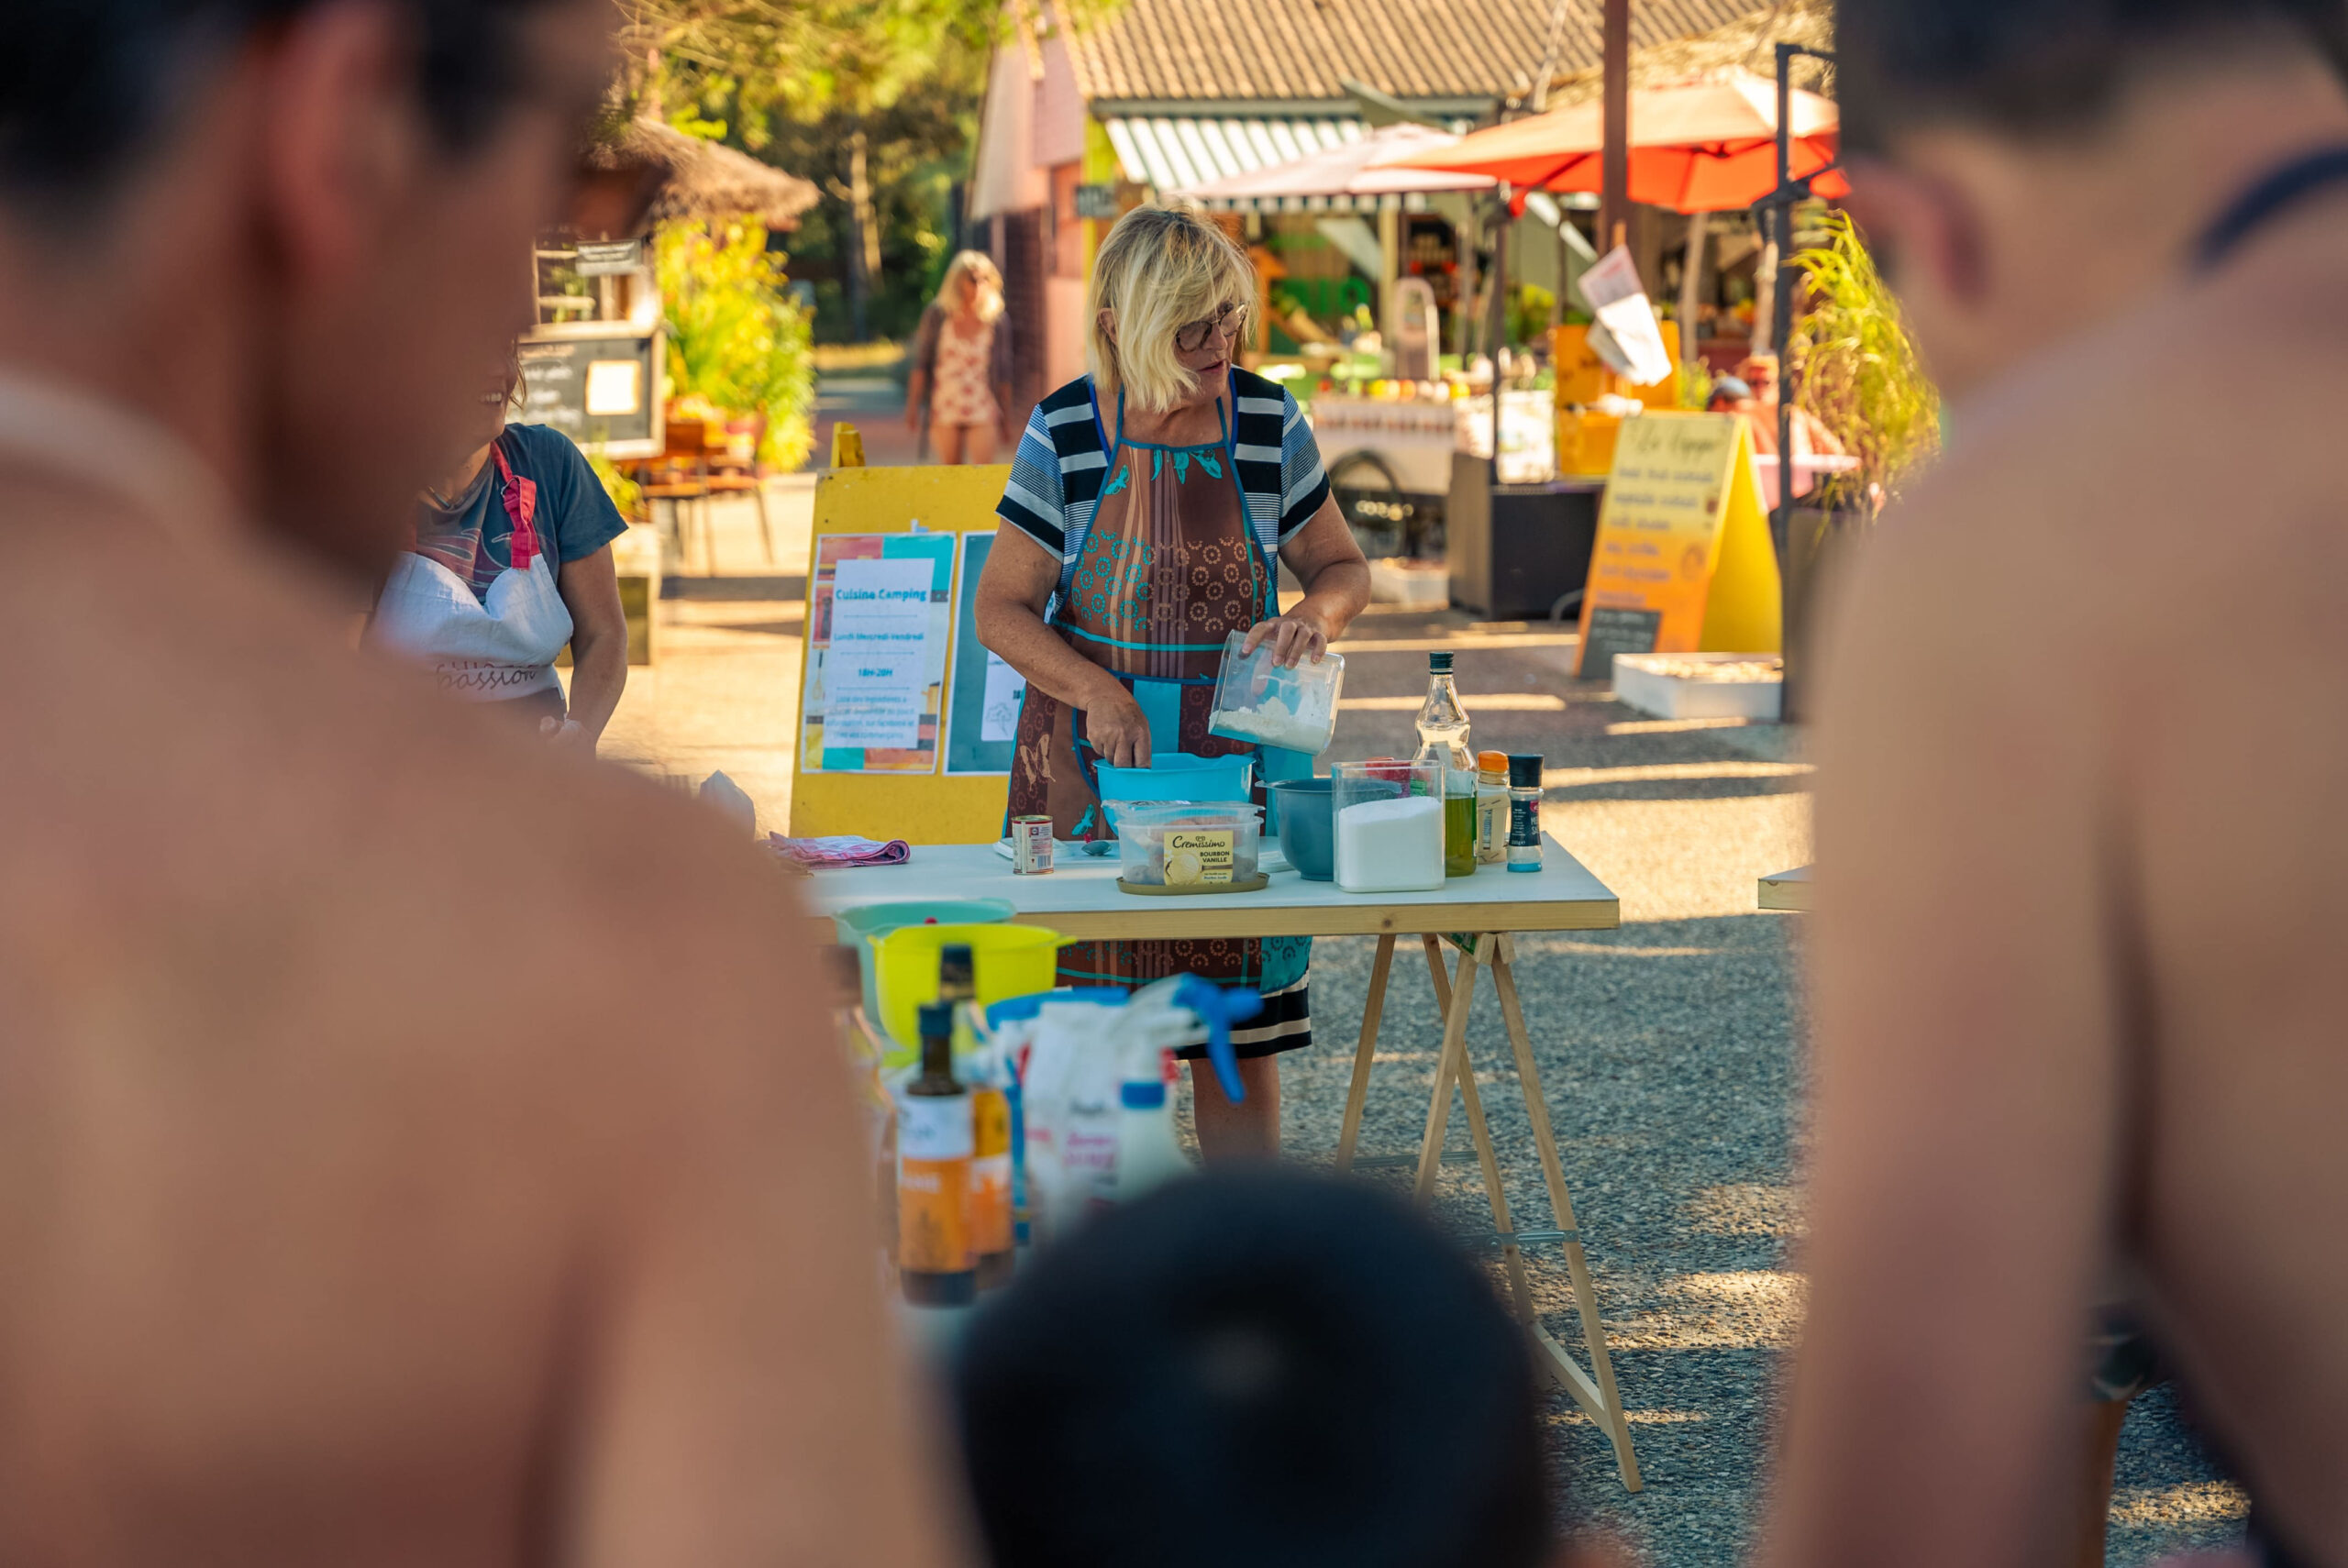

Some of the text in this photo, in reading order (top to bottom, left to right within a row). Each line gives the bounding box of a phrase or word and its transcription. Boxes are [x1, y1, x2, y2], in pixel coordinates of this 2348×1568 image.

[836, 589, 926, 602] Cuisine Camping
[1172, 835, 1225, 848] Cremissimo
